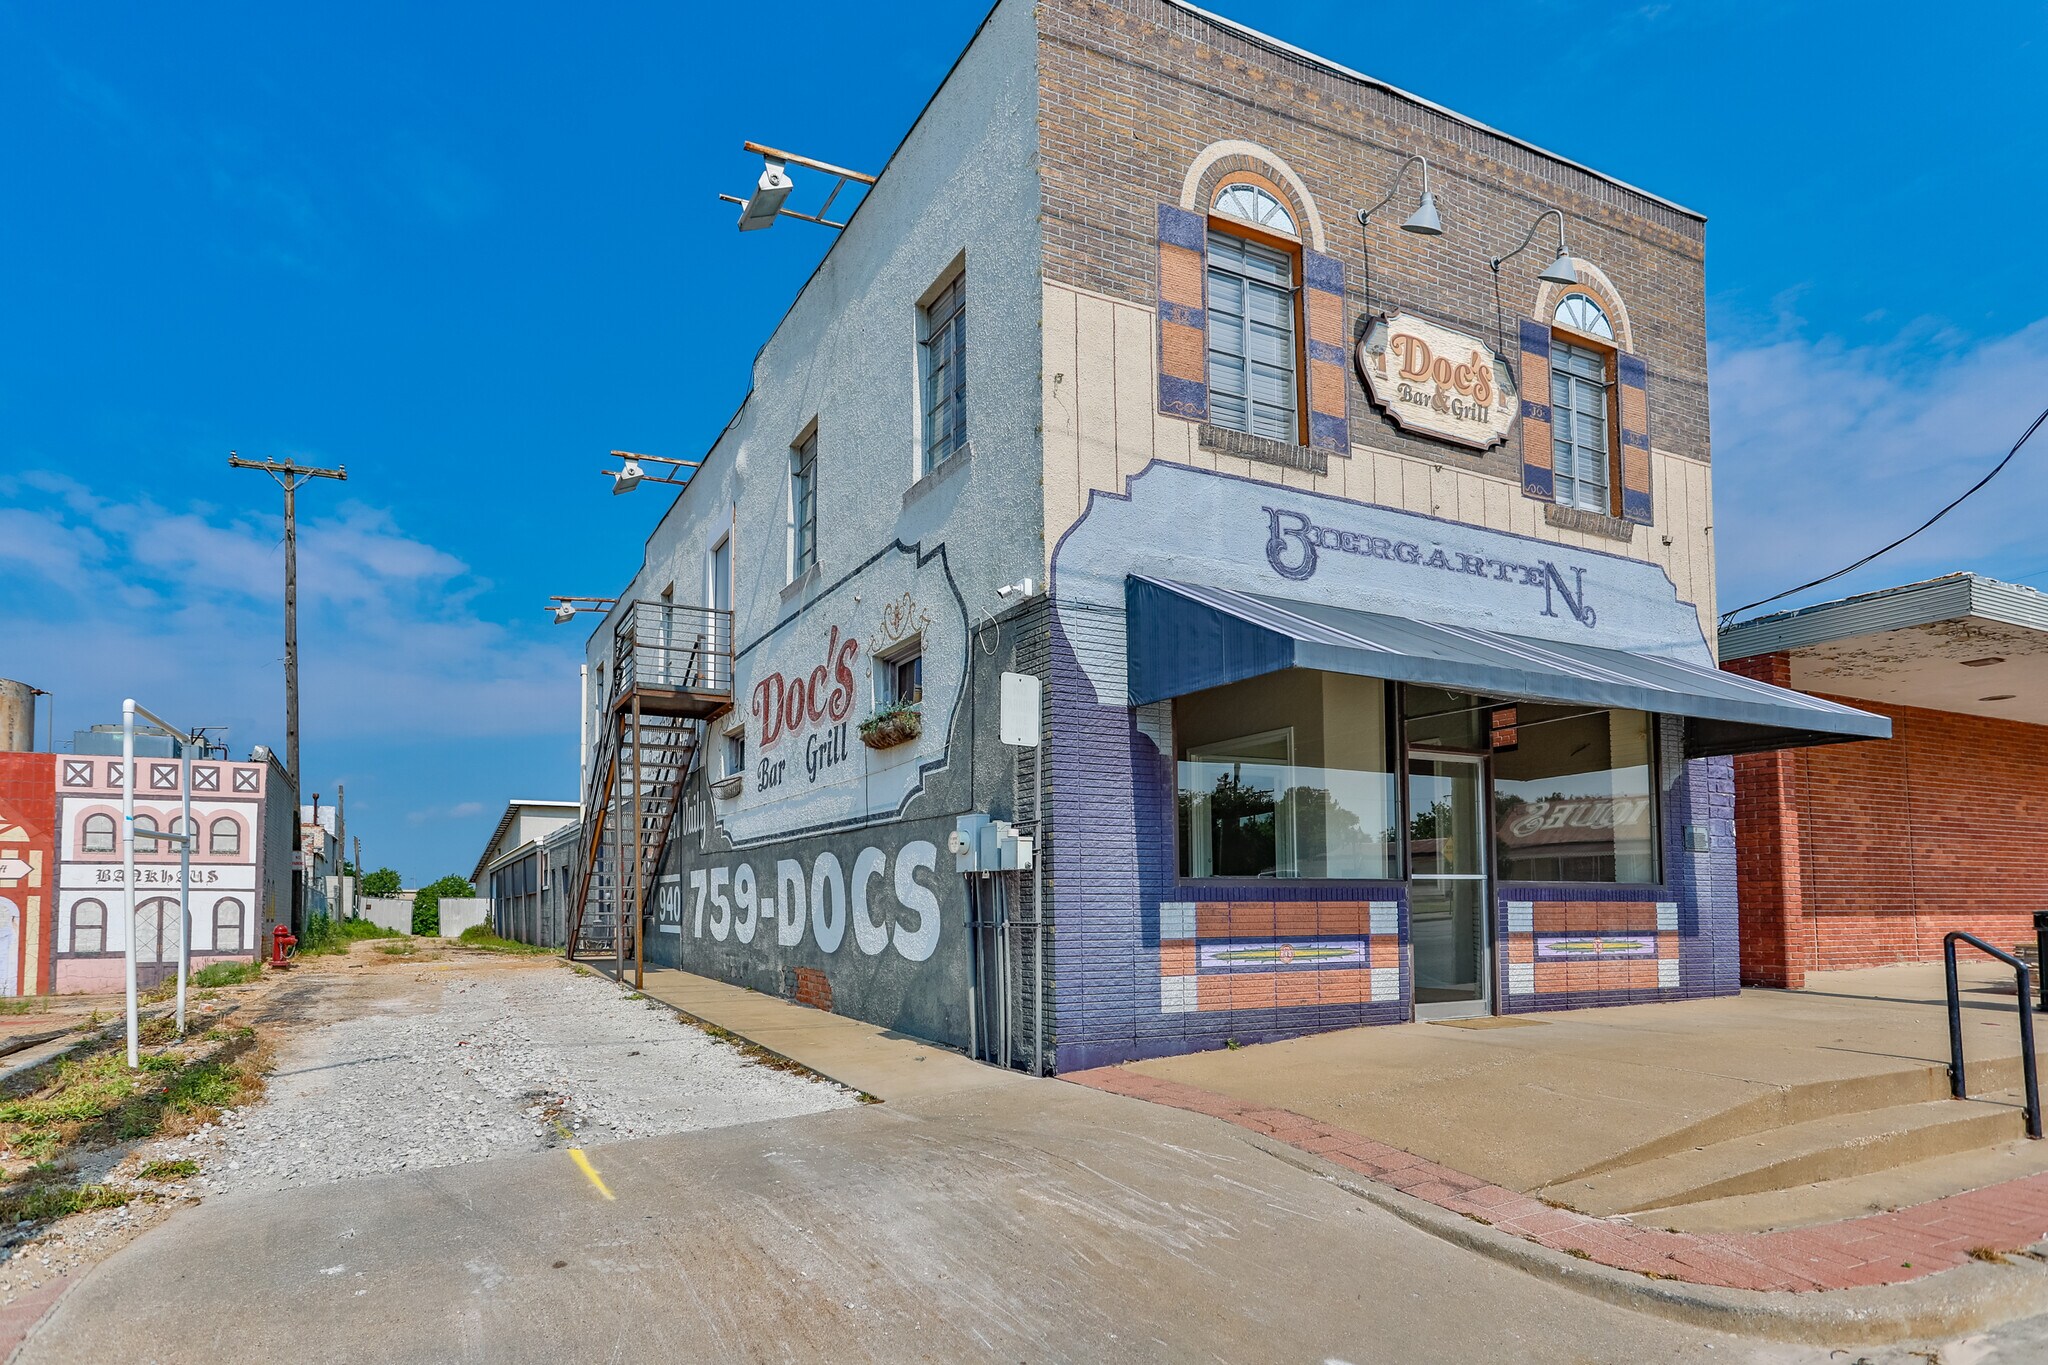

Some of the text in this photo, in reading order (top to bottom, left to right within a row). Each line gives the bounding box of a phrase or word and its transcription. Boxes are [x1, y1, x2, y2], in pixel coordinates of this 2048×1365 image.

[1391, 334, 1493, 407] Doc's
[1398, 383, 1489, 423] Bar & Grill
[1262, 506, 1597, 628] BIERGARTEN
[757, 721, 848, 792] Bar Grill
[682, 791, 706, 849] Daily
[659, 840, 941, 962] 940 759-DOCS
